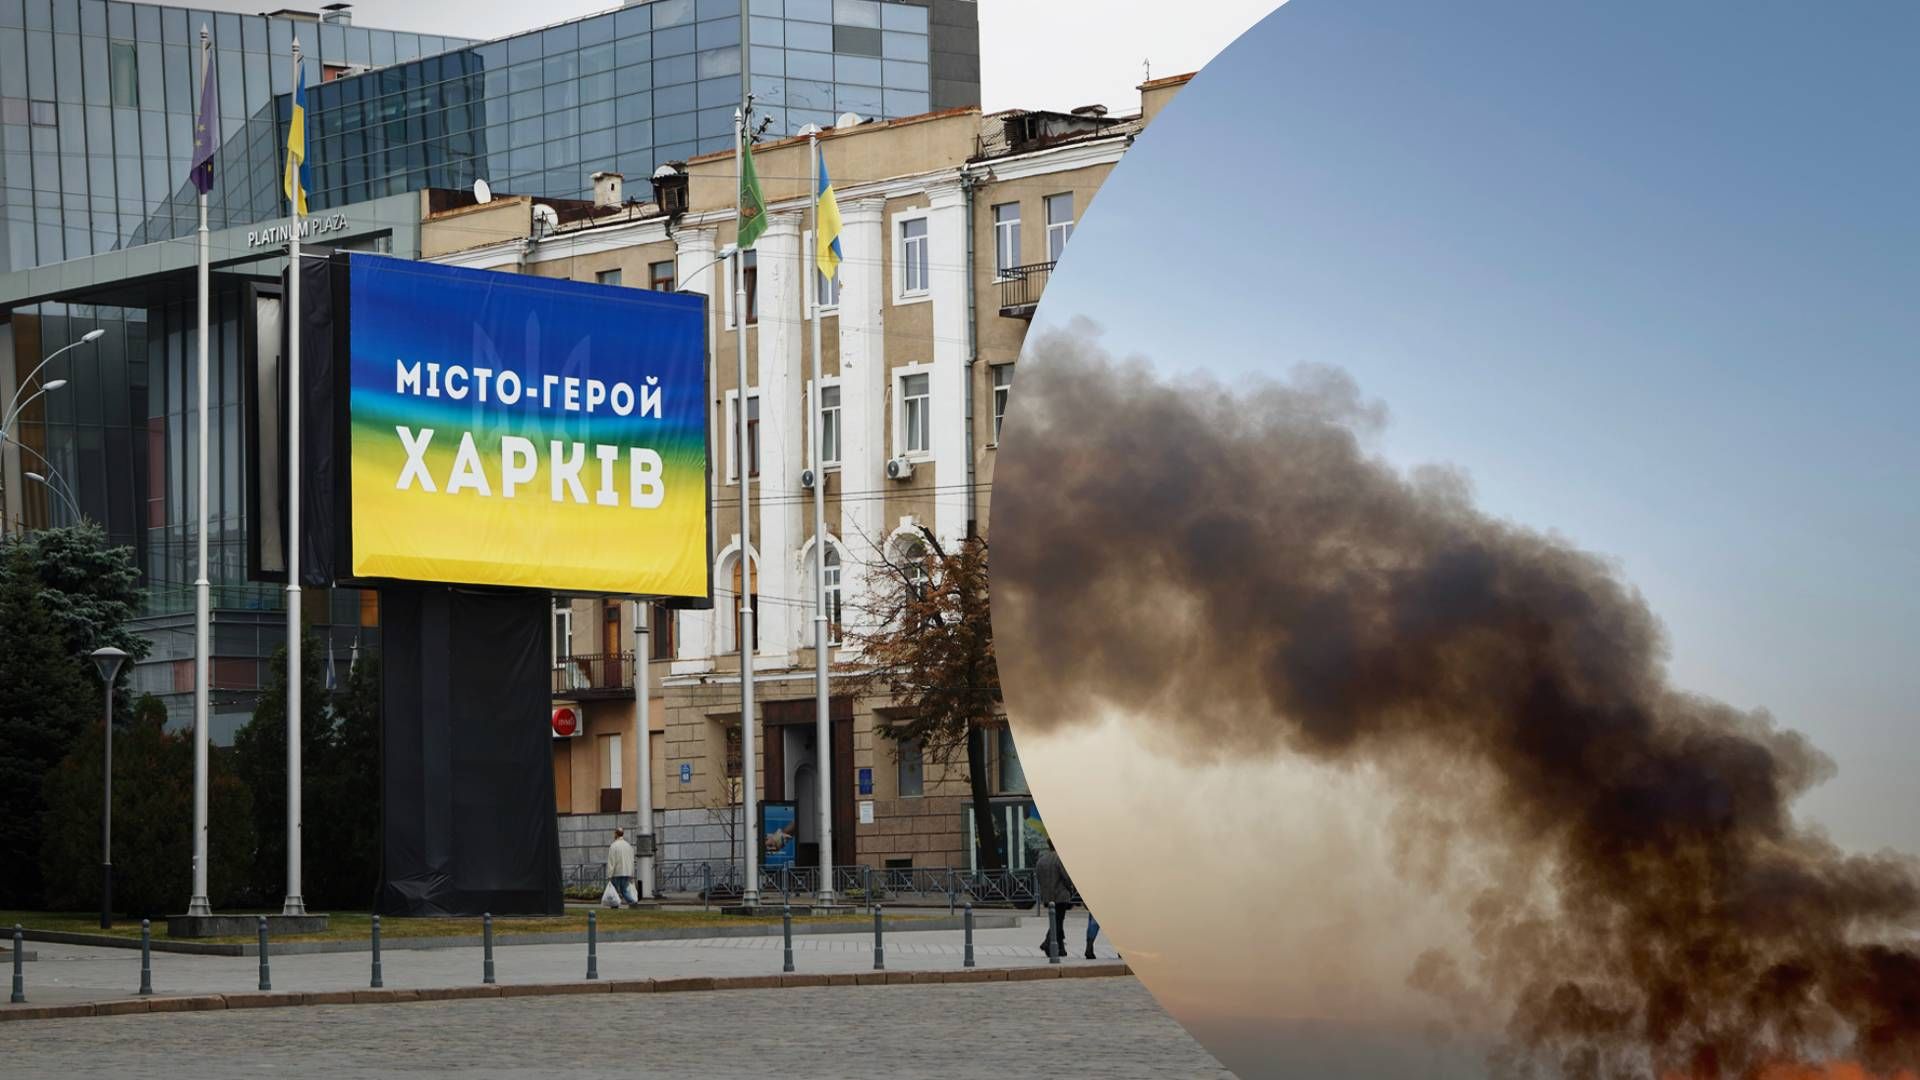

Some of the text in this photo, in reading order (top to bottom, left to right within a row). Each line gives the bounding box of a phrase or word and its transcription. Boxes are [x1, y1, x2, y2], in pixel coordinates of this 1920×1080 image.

[313, 213, 348, 234] PLAZA
[396, 359, 662, 418] МІСТО-ГЕРОЙ
[395, 426, 665, 509] ХАРКІВ
